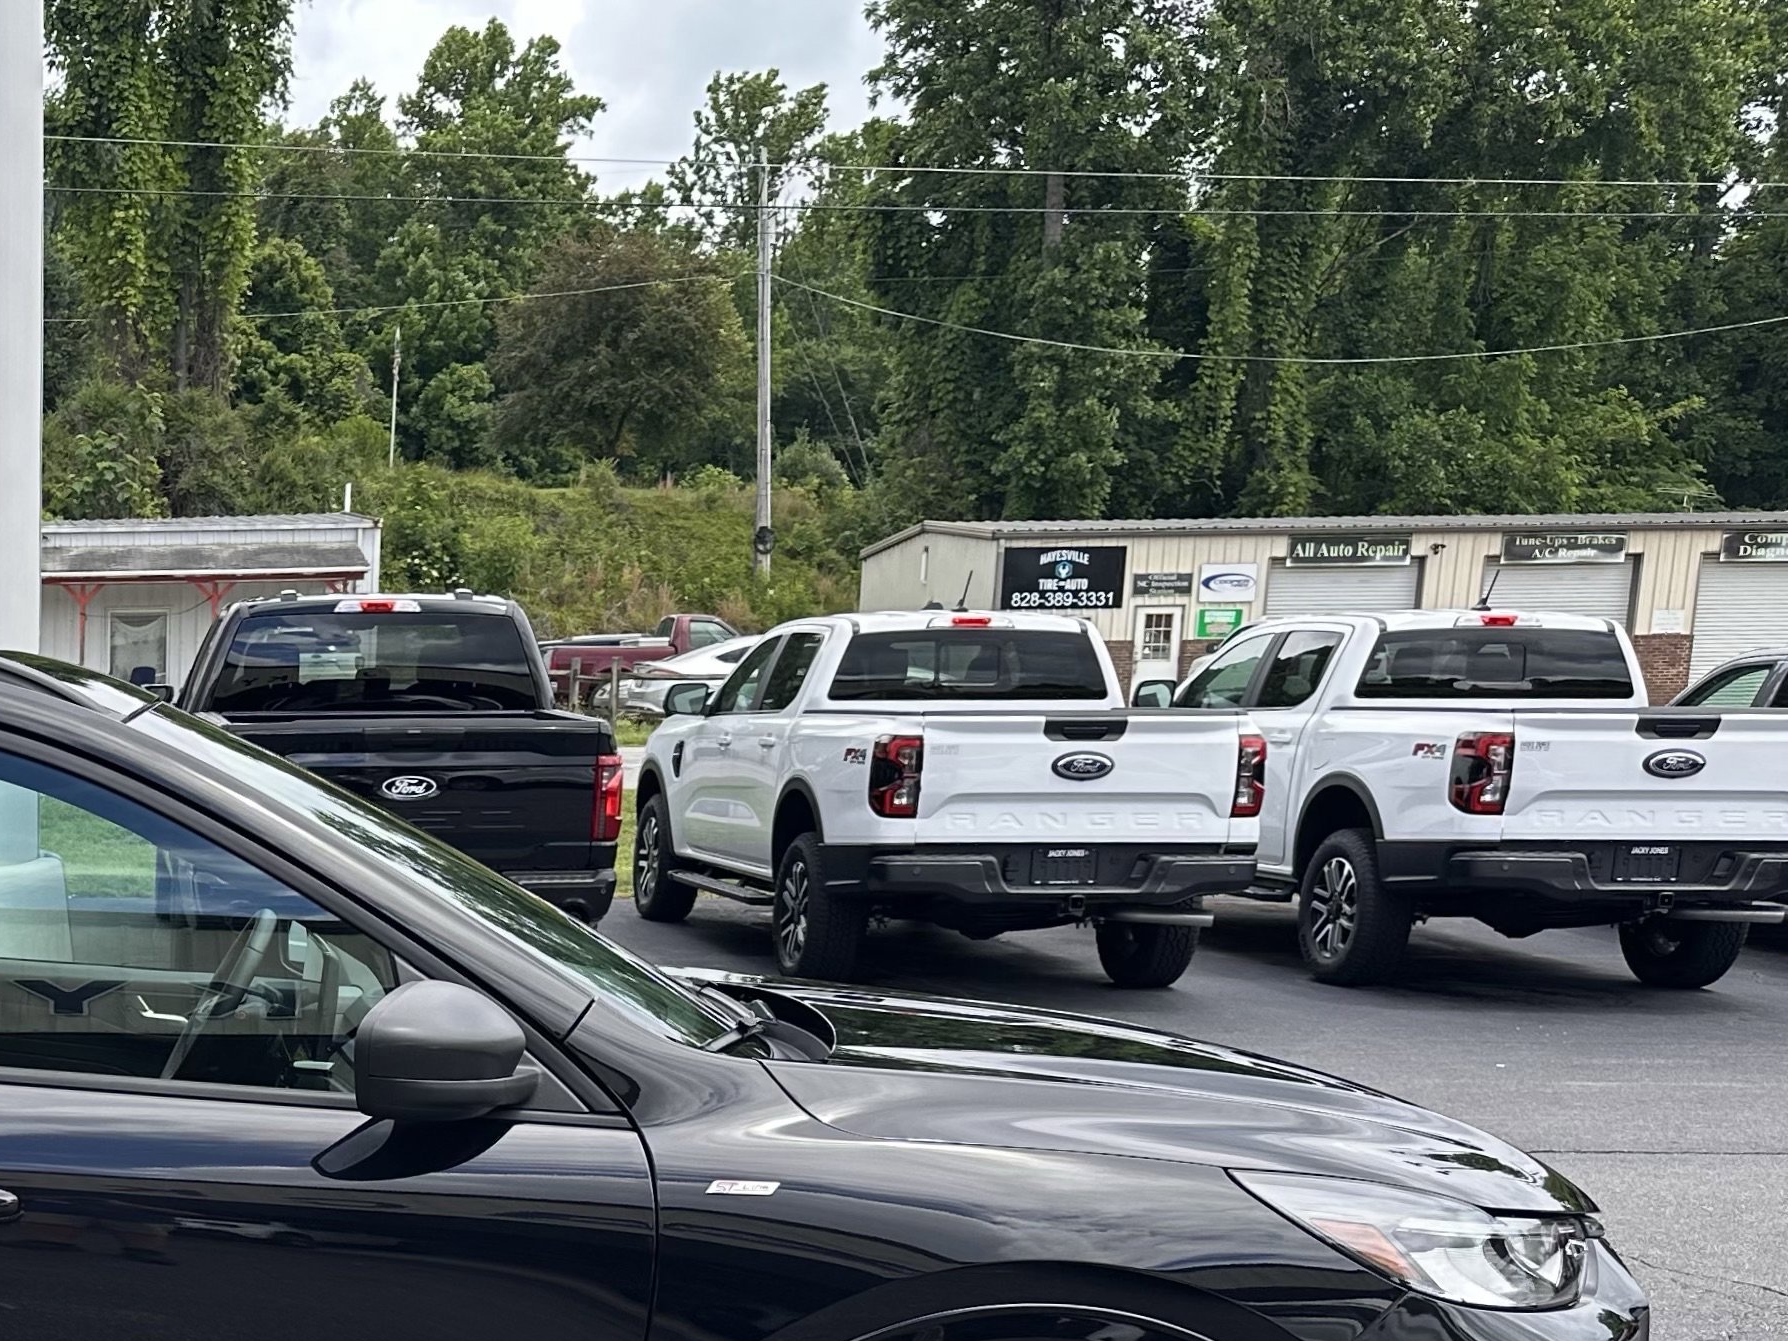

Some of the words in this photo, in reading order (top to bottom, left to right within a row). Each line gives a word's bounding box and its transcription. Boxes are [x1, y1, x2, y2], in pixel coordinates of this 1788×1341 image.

[1516, 535, 1567, 547] Tune-Ups
[1577, 535, 1616, 545] Brakes
[1040, 549, 1090, 565] HAYESVILLE
[1292, 542, 1314, 557] All
[1317, 542, 1352, 557] Auto
[1356, 541, 1407, 560] Repair
[1532, 548, 1554, 558] A/C
[1558, 548, 1596, 560] Repair
[1011, 591, 1114, 607] 828-389-3331
[844, 748, 867, 762] FX4
[1412, 743, 1446, 756] FX4
[1070, 758, 1101, 773] Ford
[391, 779, 428, 795] Ford
[945, 811, 1204, 831] RANGER
